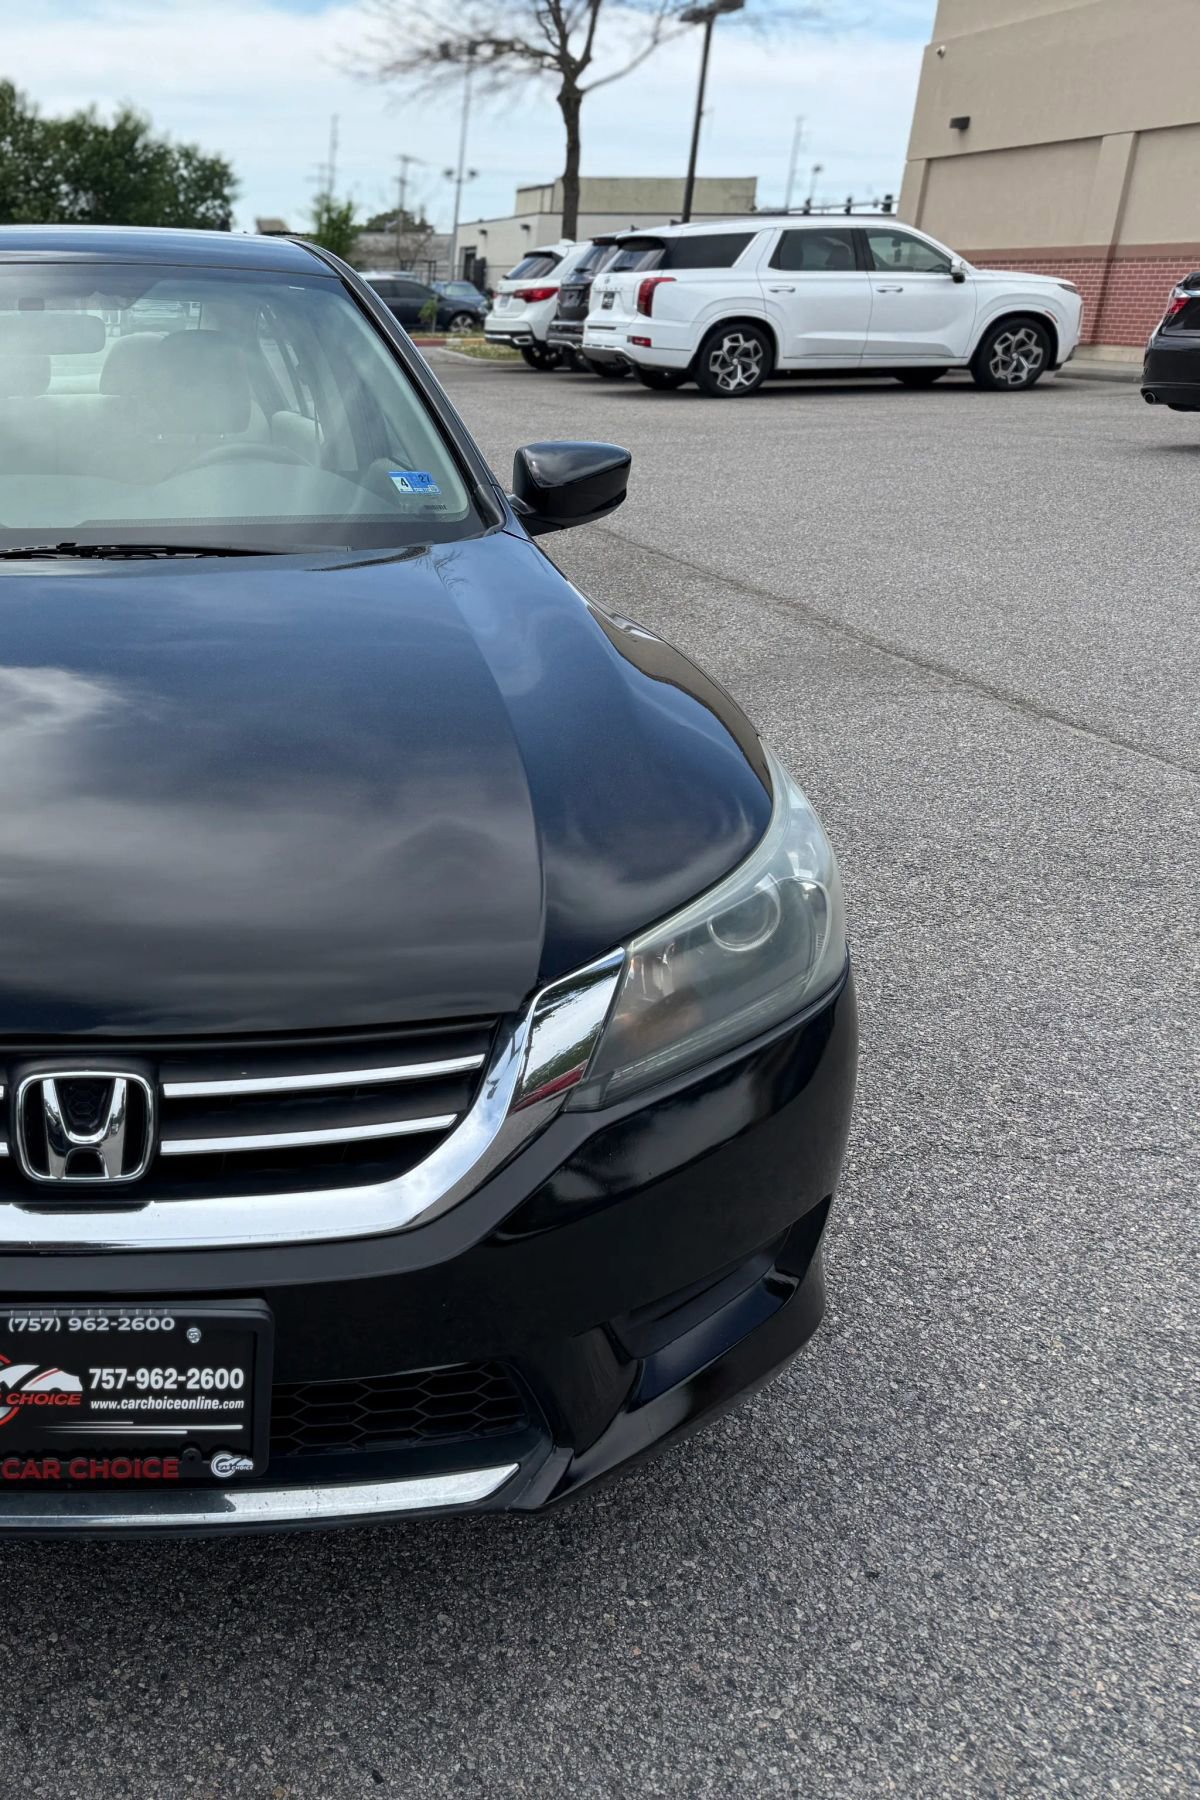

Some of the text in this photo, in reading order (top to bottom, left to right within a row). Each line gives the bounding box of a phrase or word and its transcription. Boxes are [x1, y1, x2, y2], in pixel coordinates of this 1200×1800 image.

[400, 478, 409, 487] 4
[7, 1316, 175, 1332] (757) 962-2600
[88, 1367, 245, 1390] 757-962-2600
[6, 1392, 82, 1406] CHOICE
[90, 1395, 245, 1410] www.carchoiceonline.com
[0, 1457, 180, 1479] CAR CHOICE
